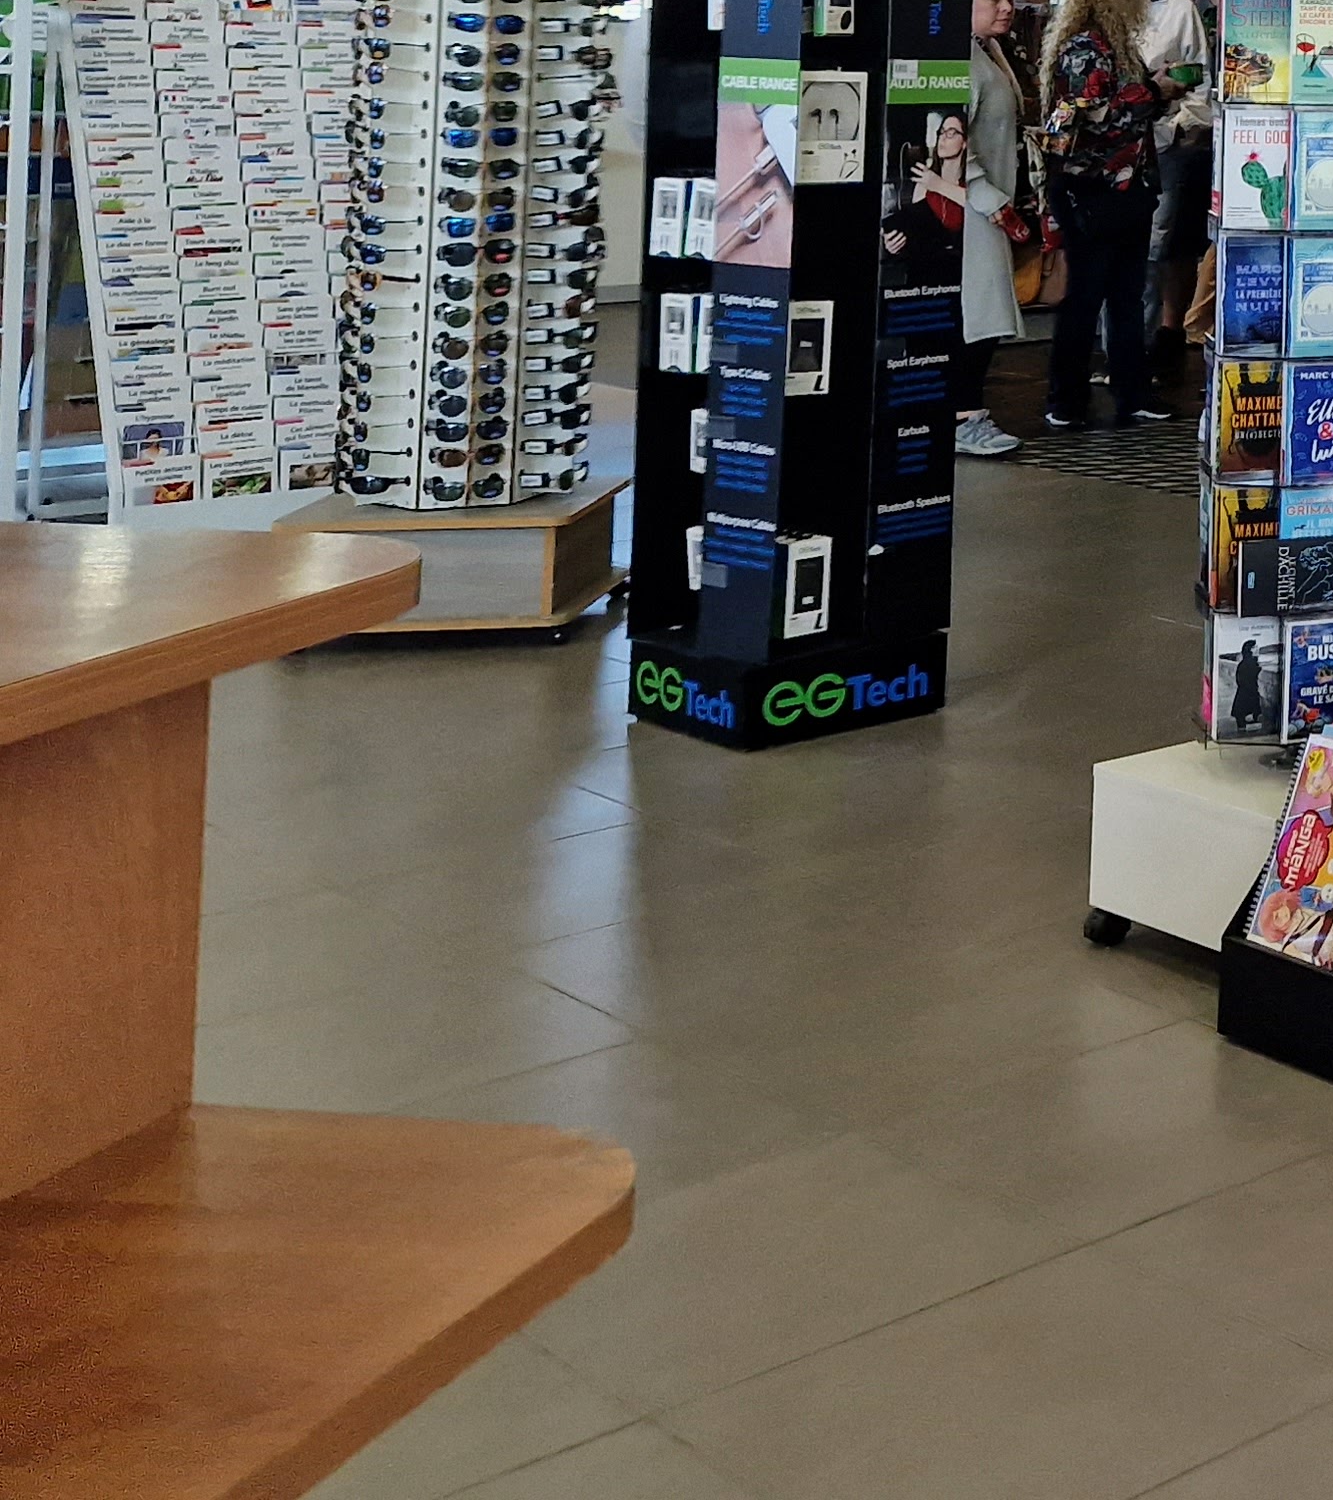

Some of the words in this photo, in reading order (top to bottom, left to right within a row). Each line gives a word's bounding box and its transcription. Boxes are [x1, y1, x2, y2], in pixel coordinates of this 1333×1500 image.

[721, 75, 758, 90] CABLE
[759, 76, 797, 92] RANGE
[928, 76, 971, 90] RANGE
[1232, 130, 1261, 144] FEEL
[1236, 276, 1282, 287] LEVY
[884, 286, 920, 300] Bluetooth
[921, 284, 961, 297] Earphones
[887, 357, 907, 371] Sport
[908, 354, 949, 367] Earphones
[1300, 371, 1329, 379] MARC
[1237, 396, 1282, 411] MAXIME
[897, 424, 930, 437] Earbuds
[877, 501, 914, 514] Bluetooth
[916, 494, 951, 509] Speakers
[1276, 545, 1291, 612] D'ACHILLE
